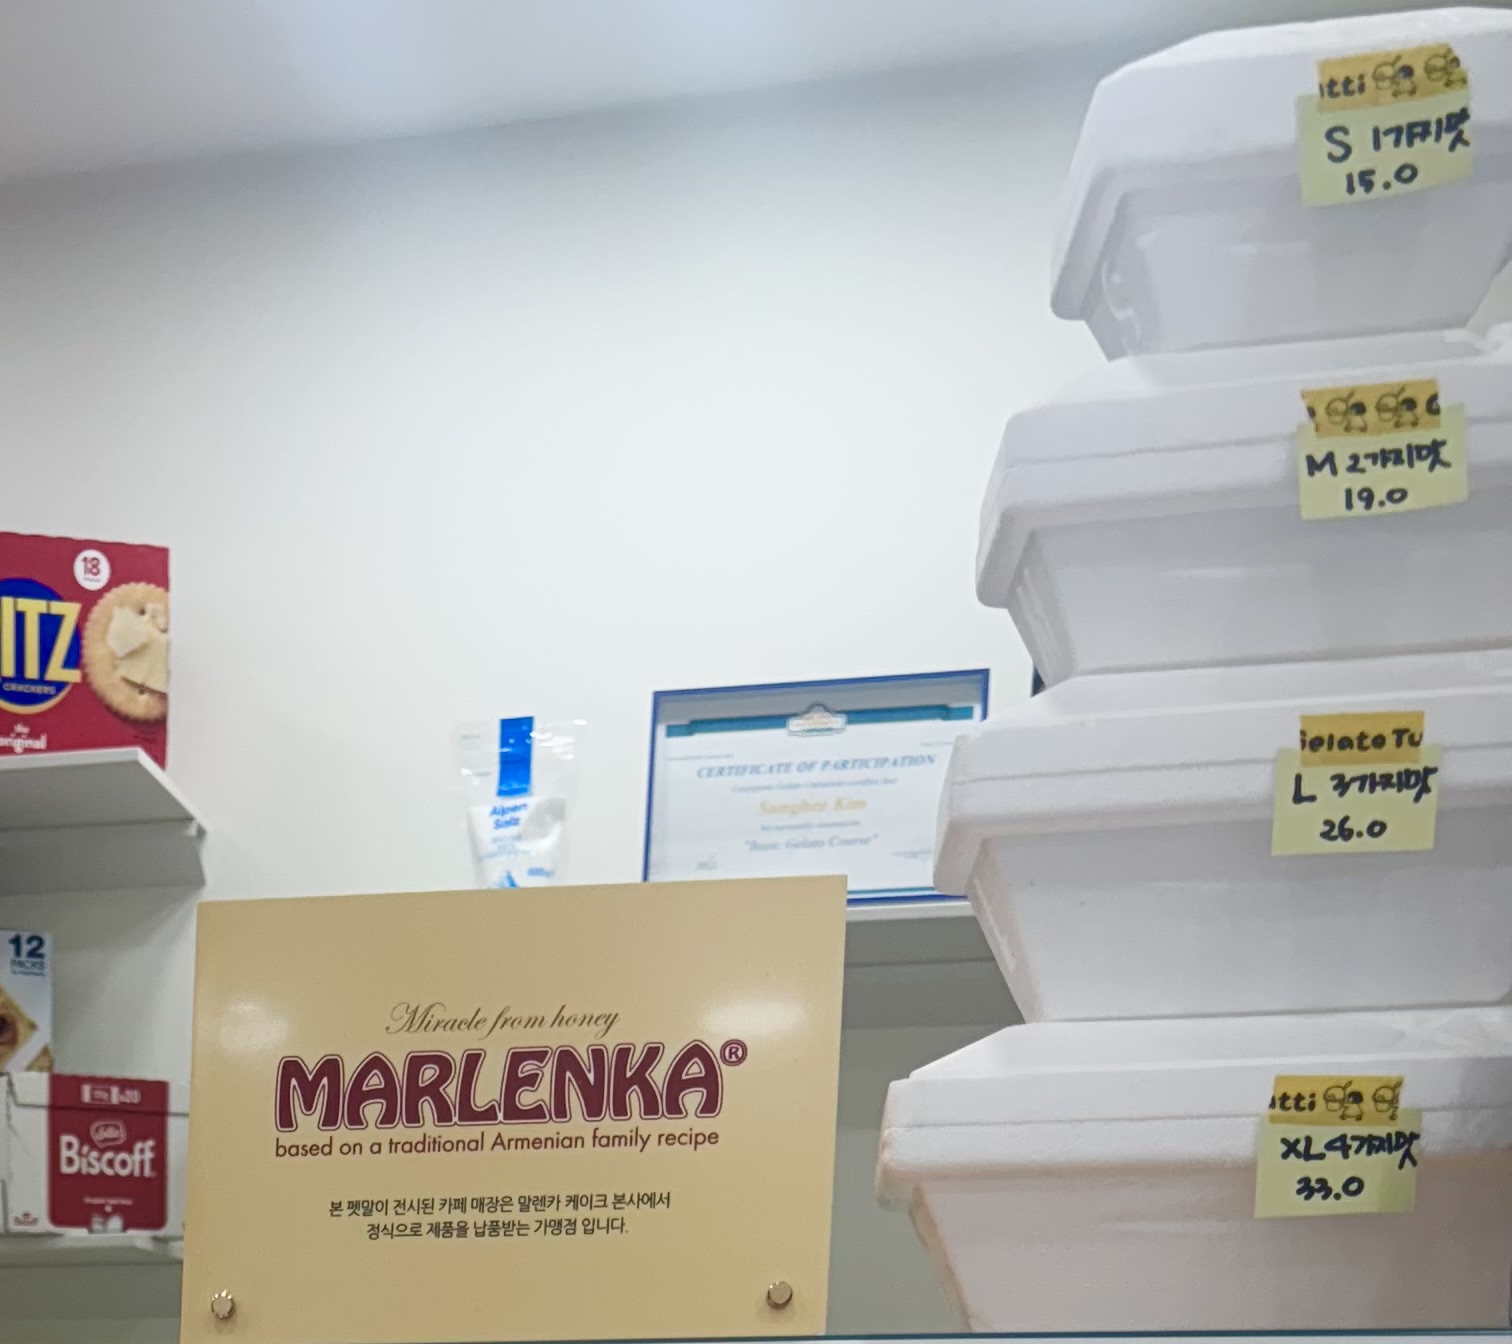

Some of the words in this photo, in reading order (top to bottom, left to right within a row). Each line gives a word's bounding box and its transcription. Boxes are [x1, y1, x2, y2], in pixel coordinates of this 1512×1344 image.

[1325, 125, 1352, 162] S
[1372, 107, 1470, 152] 1가지맛
[1346, 163, 1418, 195] 15.0
[1306, 453, 1337, 477] M
[1345, 438, 1451, 475] 2가지맛
[1344, 487, 1408, 512] 19.0
[81, 555, 101, 577] 18
[796, 758, 818, 773] OF
[1292, 773, 1317, 804] L
[1330, 766, 1438, 804] 3가지맛
[1319, 815, 1387, 842] 26.0
[8, 933, 46, 960] 12
[385, 1000, 487, 1036] Miracle
[485, 1010, 546, 1041] from
[548, 1006, 620, 1039] honey
[275, 1136, 333, 1158] based
[339, 1139, 364, 1157] on
[370, 1140, 382, 1155] a
[387, 1131, 485, 1155] traditional
[490, 1129, 586, 1152] Armenian
[591, 1126, 652, 1154] family
[656, 1128, 720, 1151] recipe
[1280, 1135, 1325, 1162] XL
[58, 1134, 156, 1179] Biscoff
[1295, 1176, 1364, 1200] 33.0
[329, 1201, 344, 1217] 본
[392, 1197, 434, 1216] 전시된
[438, 1196, 468, 1215] 카페
[470, 1194, 514, 1214] 매장은
[517, 1193, 561, 1212] 말렌카
[565, 1191, 609, 1211] 케이크
[611, 1190, 672, 1210] 본사에서
[366, 1222, 423, 1240] 정식으로
[426, 1220, 470, 1239] 제품을
[473, 1219, 530, 1238] 납품받는
[534, 1218, 578, 1237] 가맹점
[581, 1216, 630, 1236] 입니다.
